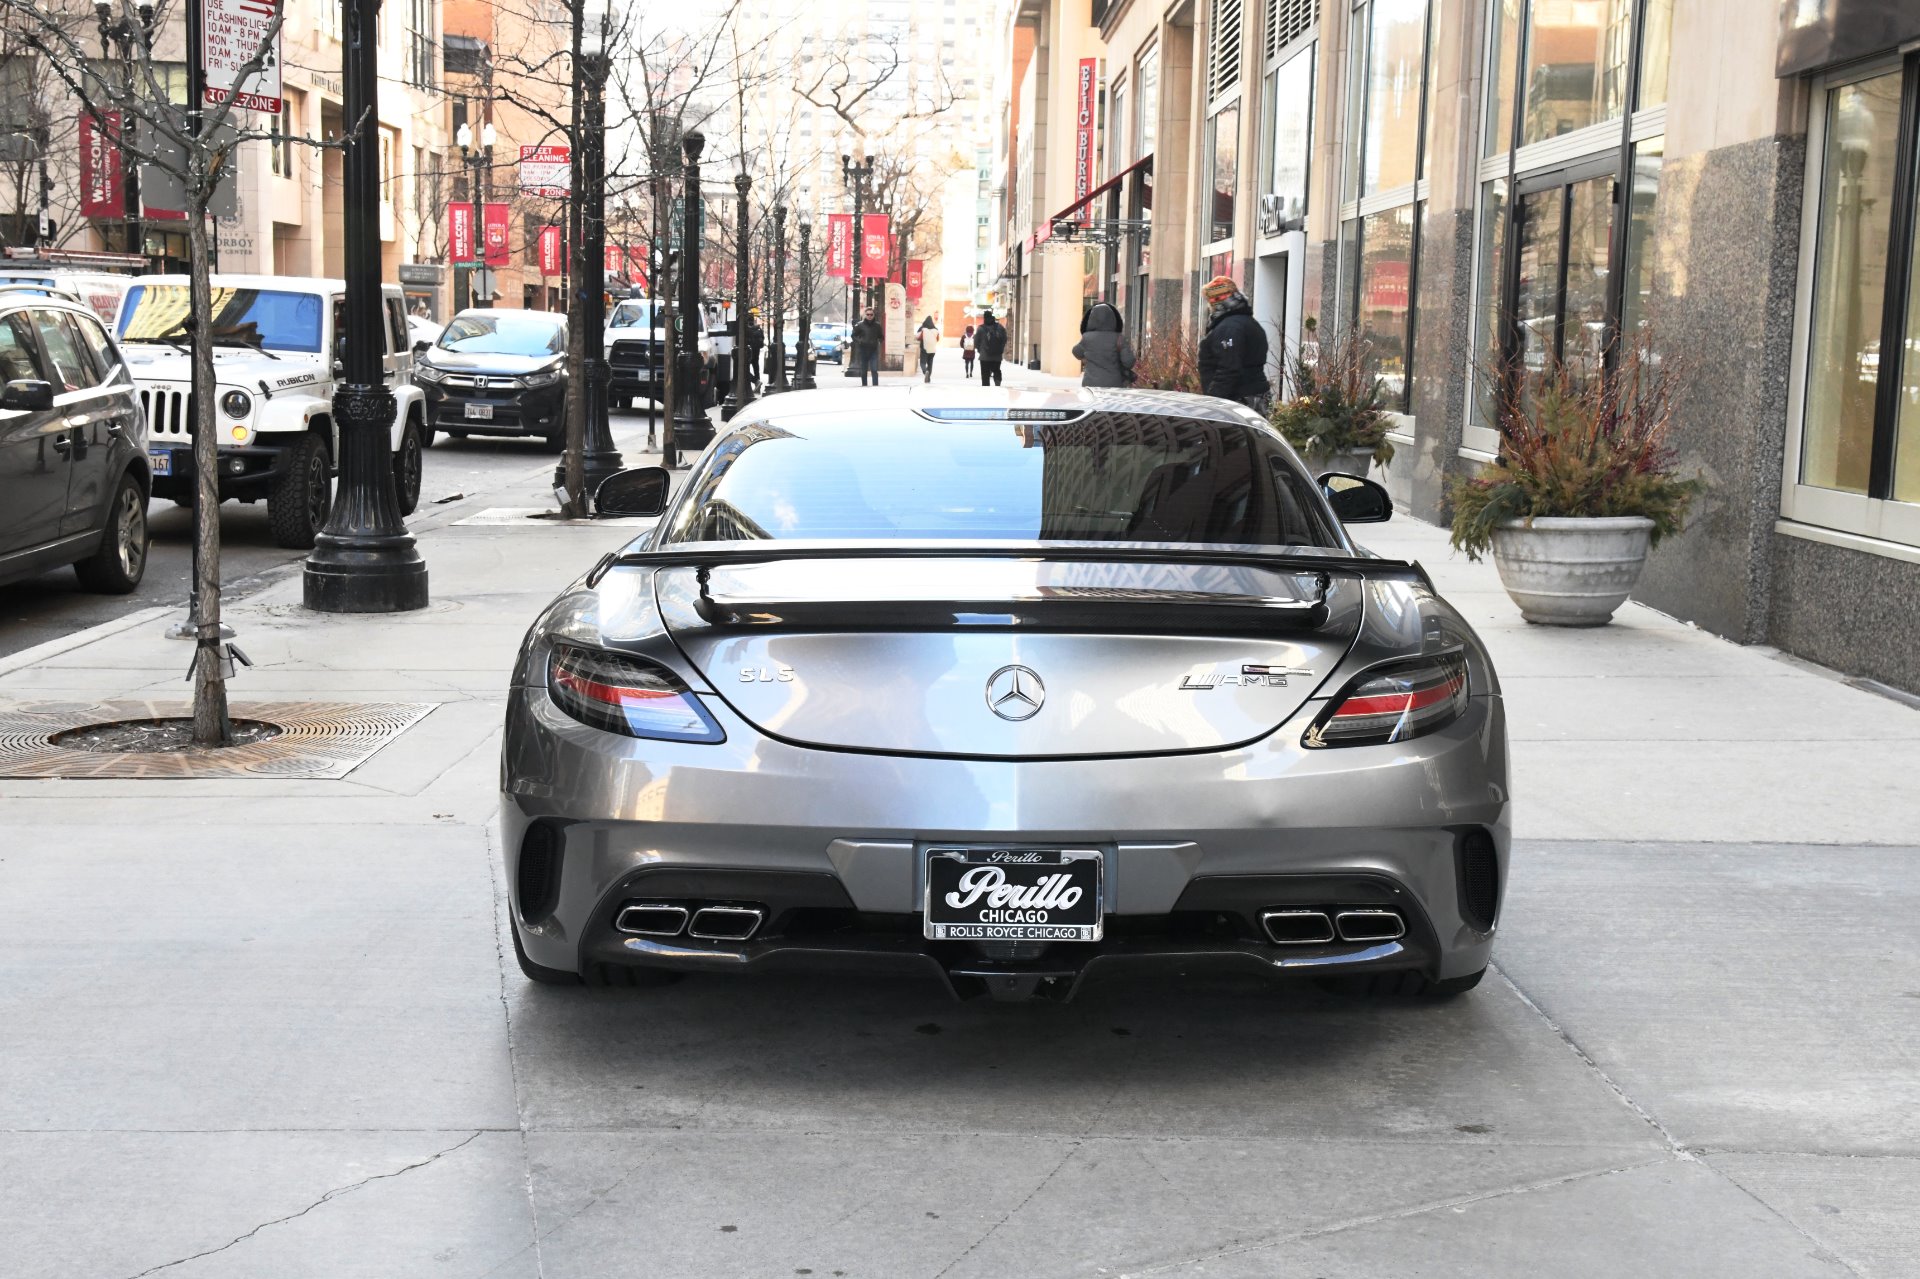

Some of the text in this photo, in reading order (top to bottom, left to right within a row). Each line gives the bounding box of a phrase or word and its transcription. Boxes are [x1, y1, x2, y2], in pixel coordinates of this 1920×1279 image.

[207, 0, 224, 10] USE
[207, 10, 273, 30] FLASHING LIGHT
[208, 21, 217, 32] 10
[218, 25, 232, 35] AM
[239, 28, 245, 38] 8
[247, 29, 260, 40] PM
[208, 34, 227, 46] MON
[236, 38, 261, 51] THUR
[208, 45, 217, 56] 10
[217, 49, 231, 58] AM
[239, 52, 245, 61] 6
[247, 53, 256, 63] P
[208, 57, 223, 69] FRI
[230, 61, 245, 72] SU
[208, 89, 276, 111] TO ZONE
[1079, 64, 1090, 126] EPIC
[90, 122, 104, 203] WELCOM
[455, 209, 463, 257] WELCOME
[216, 238, 254, 248] ORBOY
[276, 373, 316, 388] RUBICON
[738, 667, 795, 683] SLS
[1218, 674, 1288, 687] AMG
[986, 850, 1043, 863] Perillo
[945, 865, 1083, 910] Perillo
[979, 909, 1049, 924] CHICAGO
[950, 926, 984, 938] ROLLS
[986, 926, 1024, 938] ROYCE
[1027, 927, 1077, 939] CHICAGO
